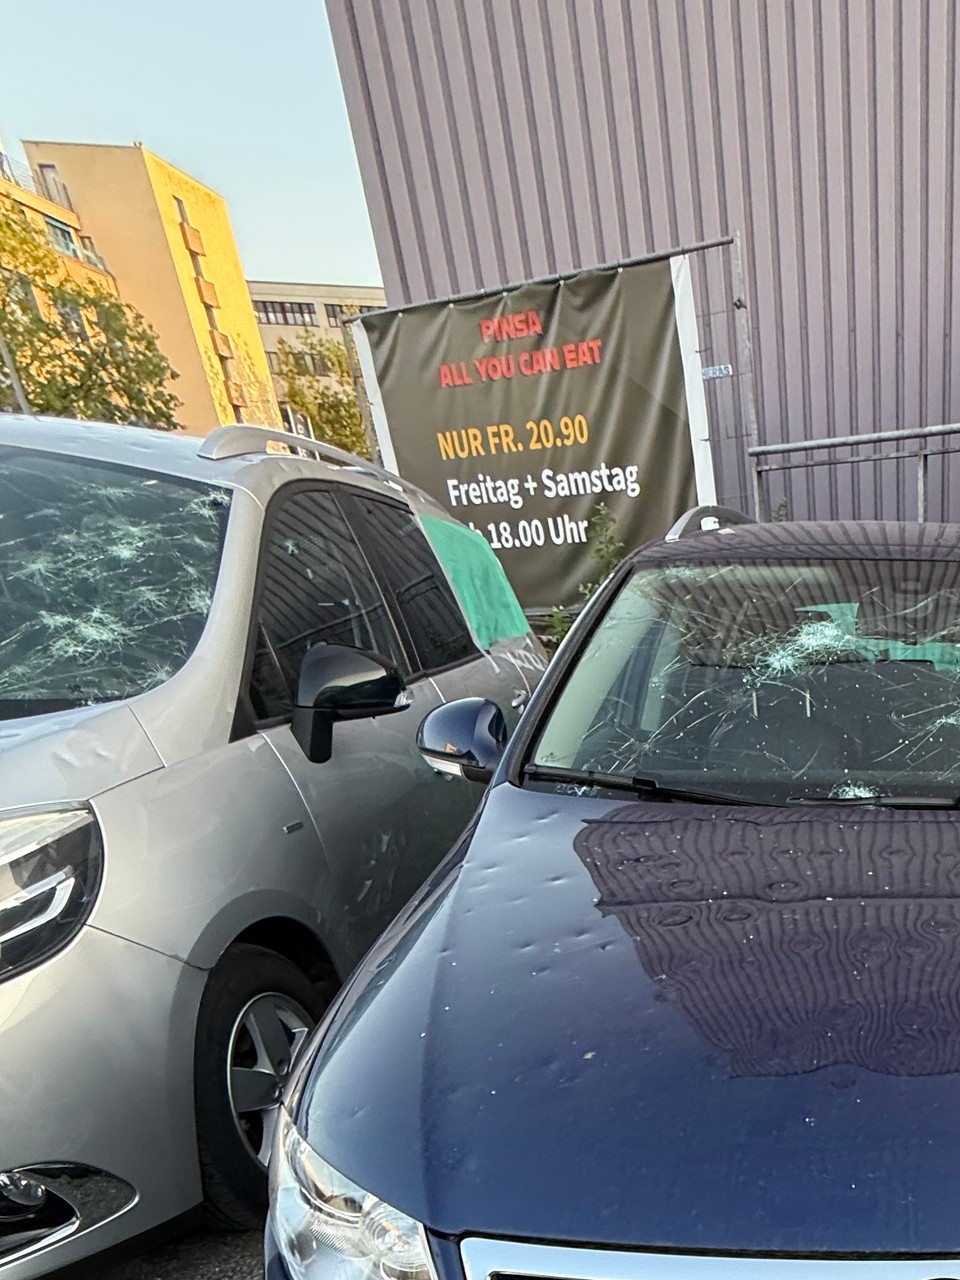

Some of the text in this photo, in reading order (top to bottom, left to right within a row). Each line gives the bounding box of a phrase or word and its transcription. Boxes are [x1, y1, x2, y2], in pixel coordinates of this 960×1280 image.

[480, 310, 543, 343] PINSA
[439, 338, 602, 388] ALL YOU CAN EAT
[437, 414, 589, 461] NUR FR. 20.90
[447, 462, 640, 509] Freitag + Samstag
[487, 519, 545, 549] 18.00
[547, 514, 588, 545] Uhr
